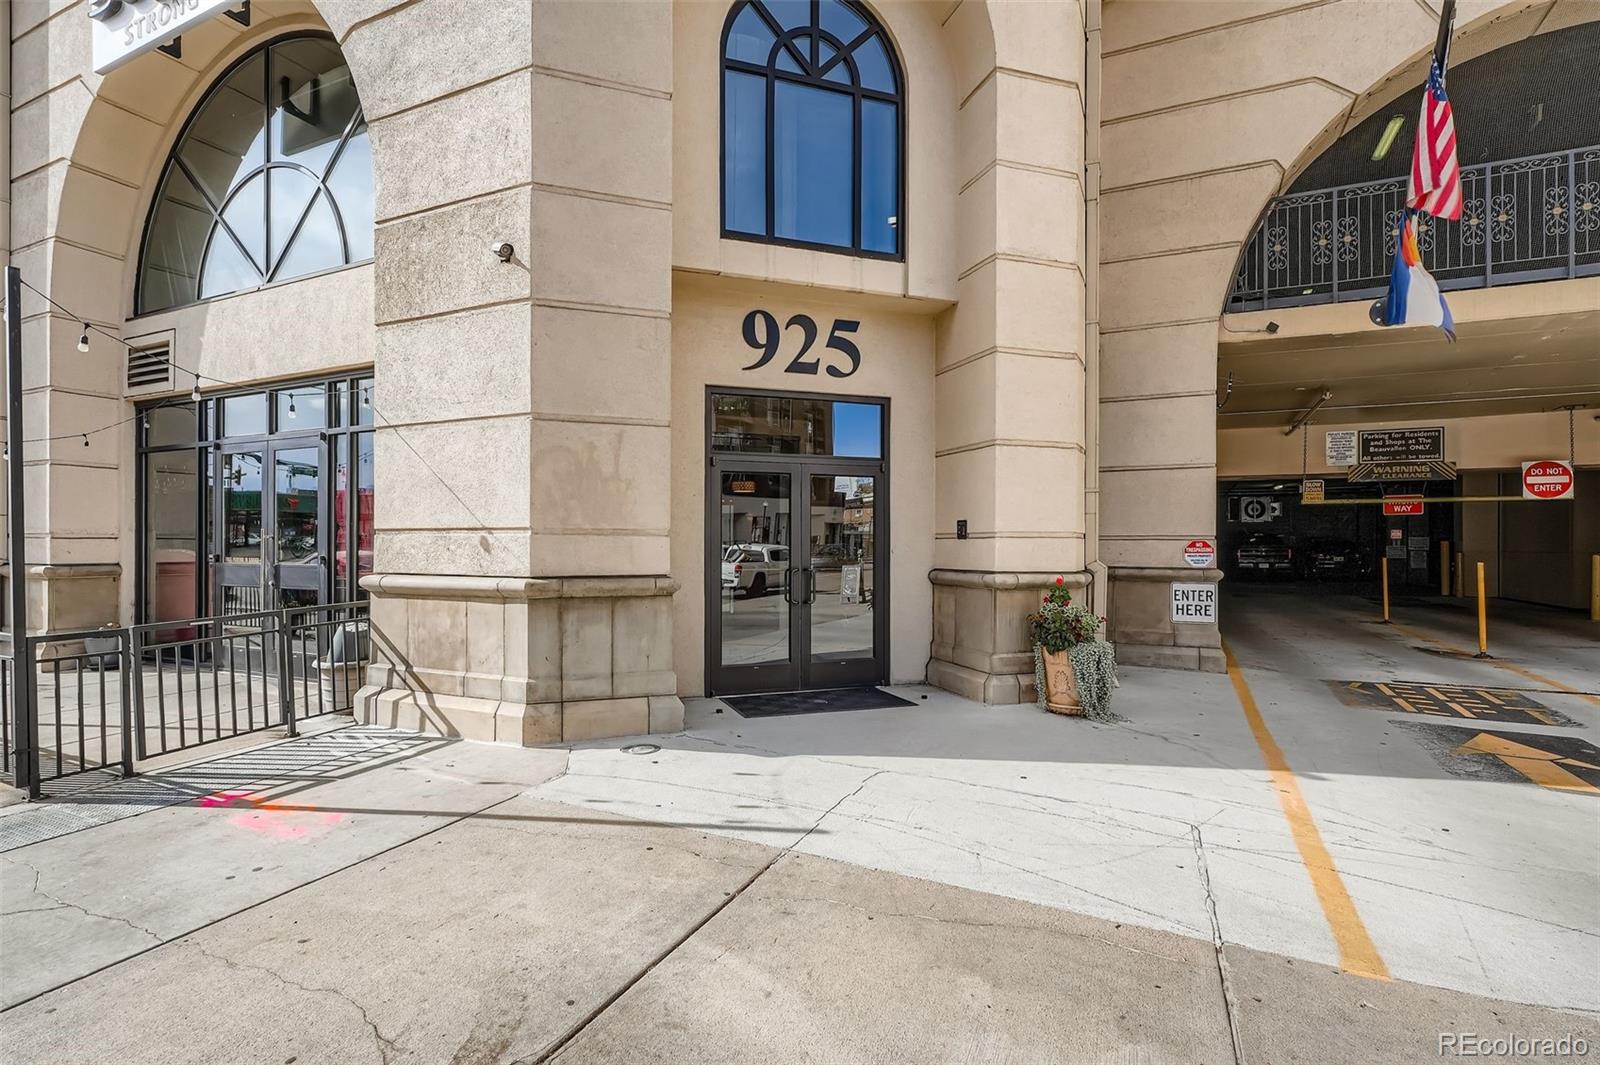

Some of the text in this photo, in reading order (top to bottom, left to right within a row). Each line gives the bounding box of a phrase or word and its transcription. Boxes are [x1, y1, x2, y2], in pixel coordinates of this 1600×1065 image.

[741, 309, 862, 378] 925
[1373, 465, 1430, 473] WARNING
[1546, 467, 1564, 475] NOT
[1534, 484, 1562, 492] ENTER
[1174, 589, 1214, 602] ENTER
[1176, 604, 1212, 617] HERE
